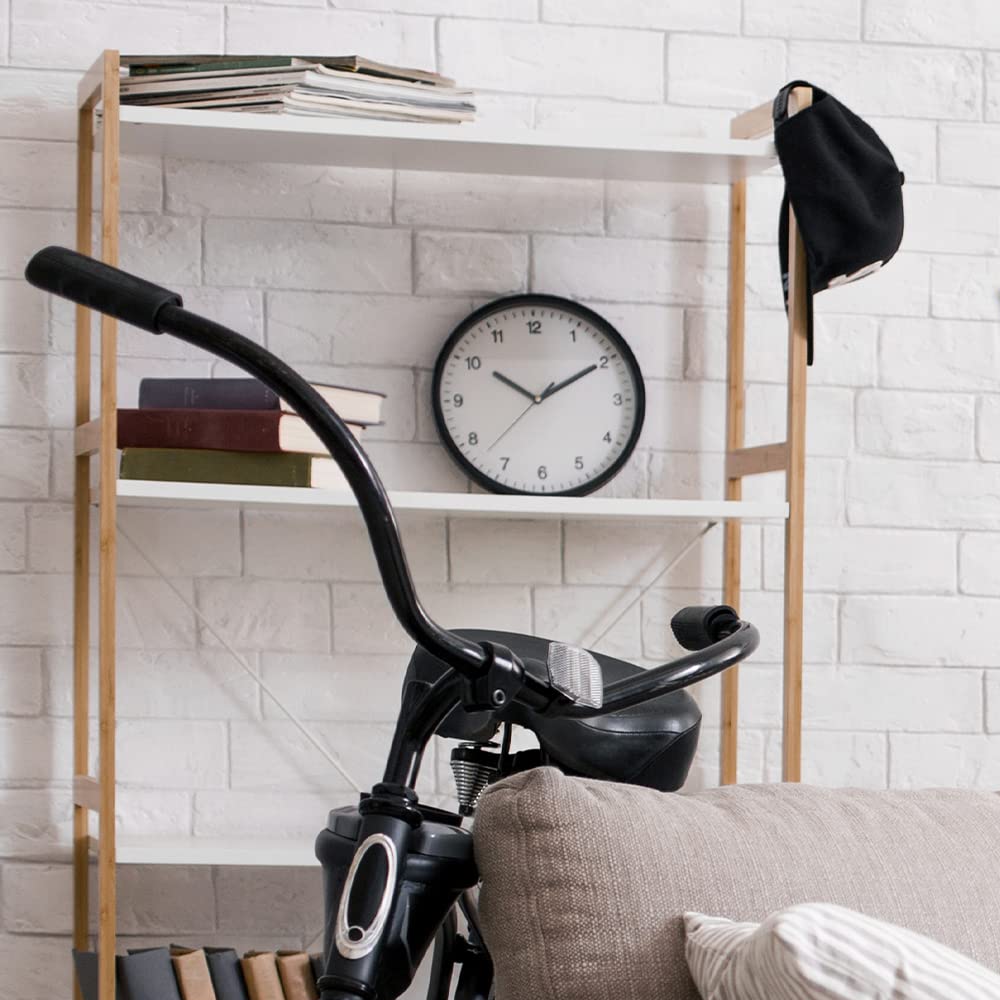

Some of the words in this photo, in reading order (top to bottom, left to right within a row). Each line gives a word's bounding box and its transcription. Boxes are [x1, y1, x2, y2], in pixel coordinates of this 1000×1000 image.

[526, 320, 542, 334] 12
[491, 330, 503, 343] 11
[570, 330, 576, 342] 1
[465, 356, 481, 370] 10
[599, 357, 609, 369] 2
[453, 394, 463, 407] 9
[613, 393, 622, 406] 3
[468, 432, 478, 445] 8
[603, 431, 612, 443] 4
[500, 457, 510, 471] 7
[574, 456, 584, 469] 5
[537, 466, 547, 479] 6
